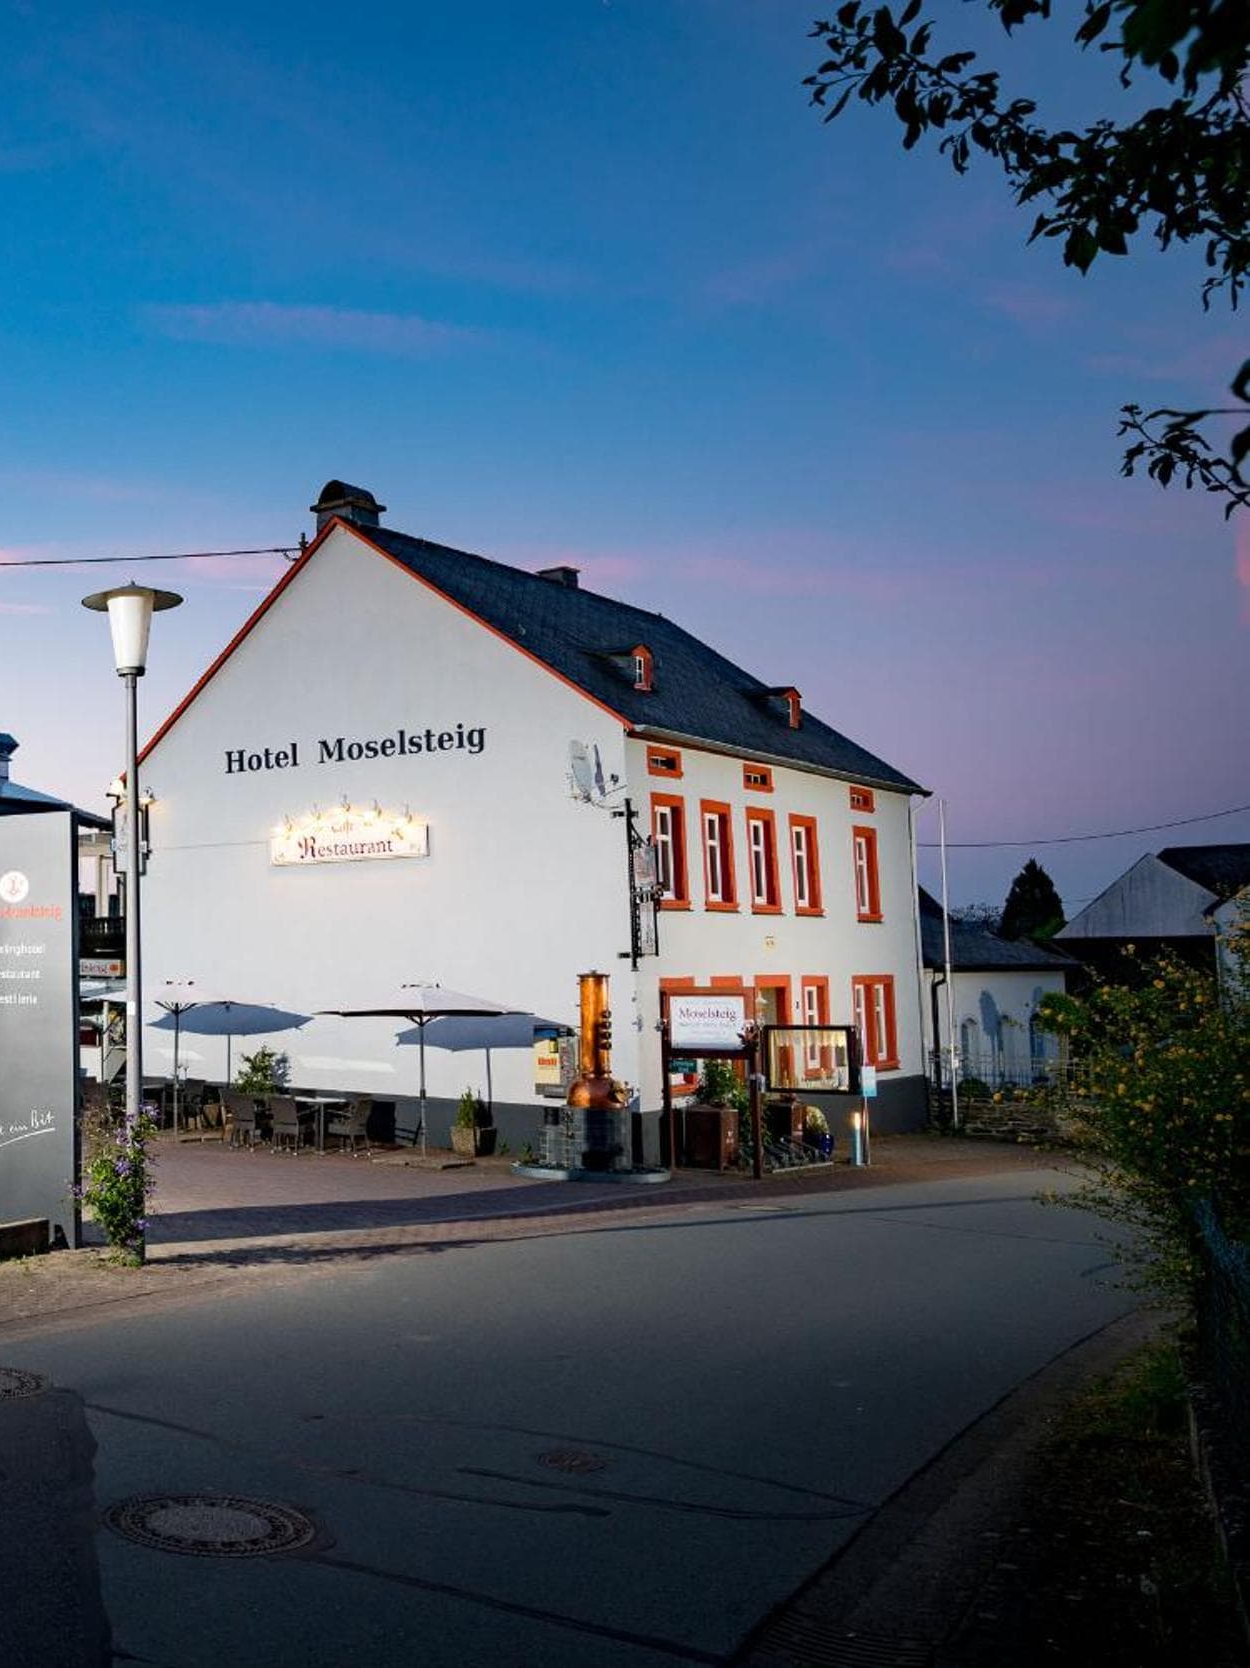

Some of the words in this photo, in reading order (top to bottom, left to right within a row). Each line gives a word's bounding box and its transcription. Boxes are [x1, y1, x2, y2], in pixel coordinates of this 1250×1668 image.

[225, 743, 299, 773] Hotel
[318, 723, 486, 763] Moselsteig
[298, 836, 394, 859] Restaurant
[679, 1007, 736, 1022] Moselsteig
[9, 1124, 28, 1134] ein
[30, 1109, 54, 1129] Bit
